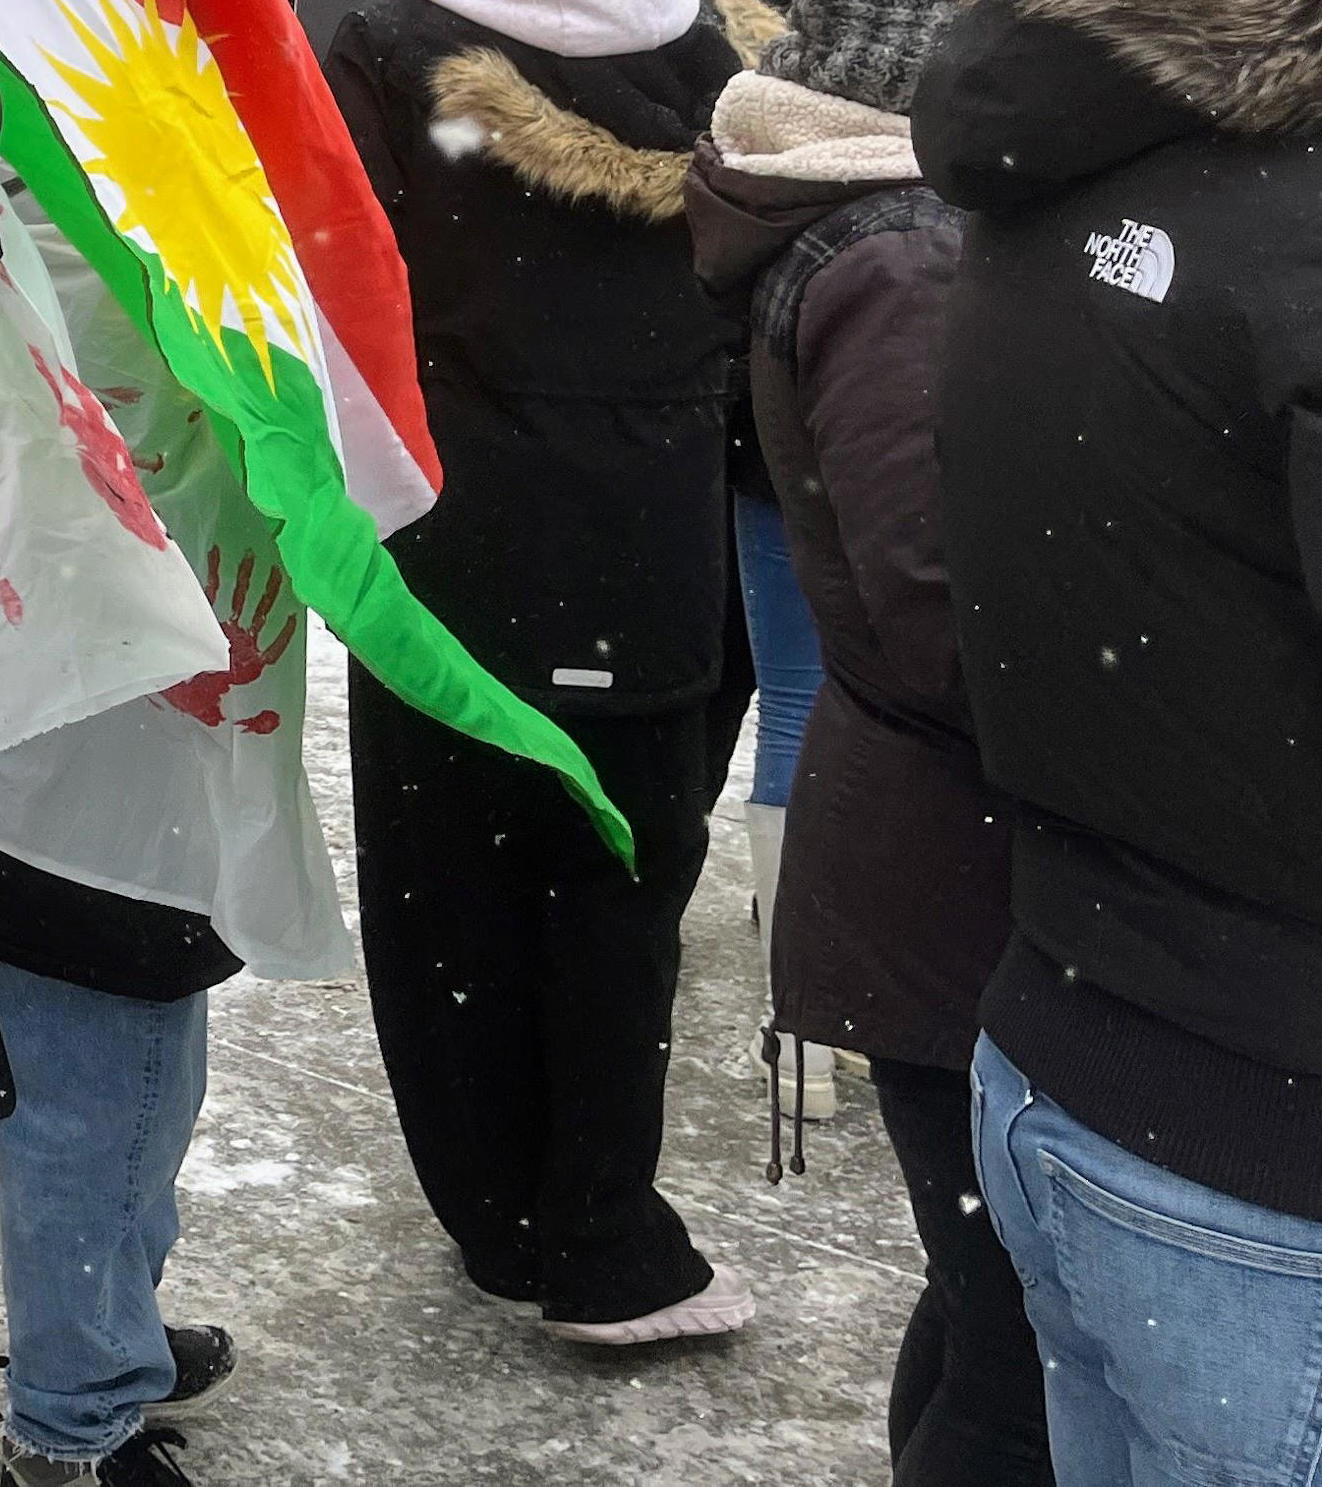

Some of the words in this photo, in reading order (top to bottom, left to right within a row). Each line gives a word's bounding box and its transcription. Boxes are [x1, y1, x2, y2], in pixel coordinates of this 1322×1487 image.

[1119, 219, 1153, 247] THE
[1083, 231, 1143, 269] NORTH
[1089, 257, 1136, 290] FACE
